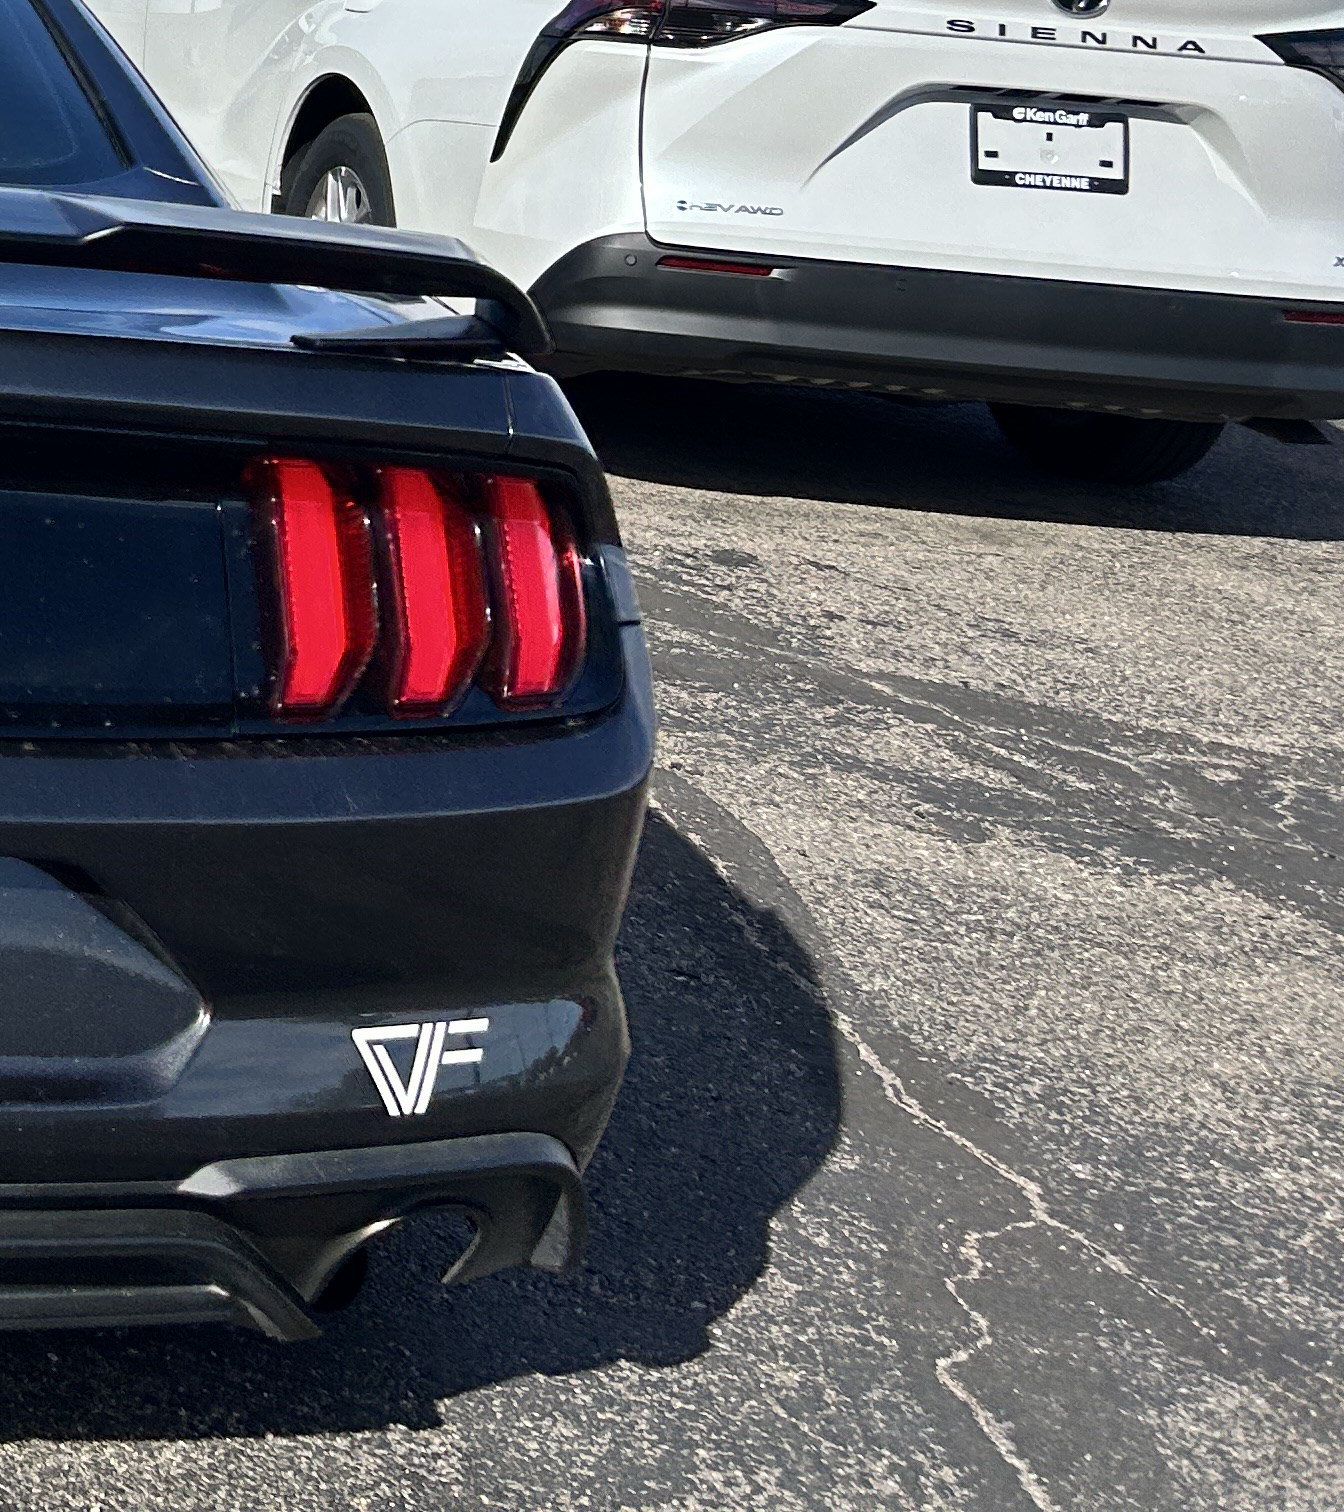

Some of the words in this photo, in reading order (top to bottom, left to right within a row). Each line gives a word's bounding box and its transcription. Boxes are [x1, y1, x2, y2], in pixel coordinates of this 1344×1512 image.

[946, 18, 1206, 54] SIENNA
[1026, 107, 1055, 123] Ken
[1055, 109, 1090, 126] Garff
[1014, 172, 1091, 190] CHEYENNE
[735, 205, 783, 216] AWD
